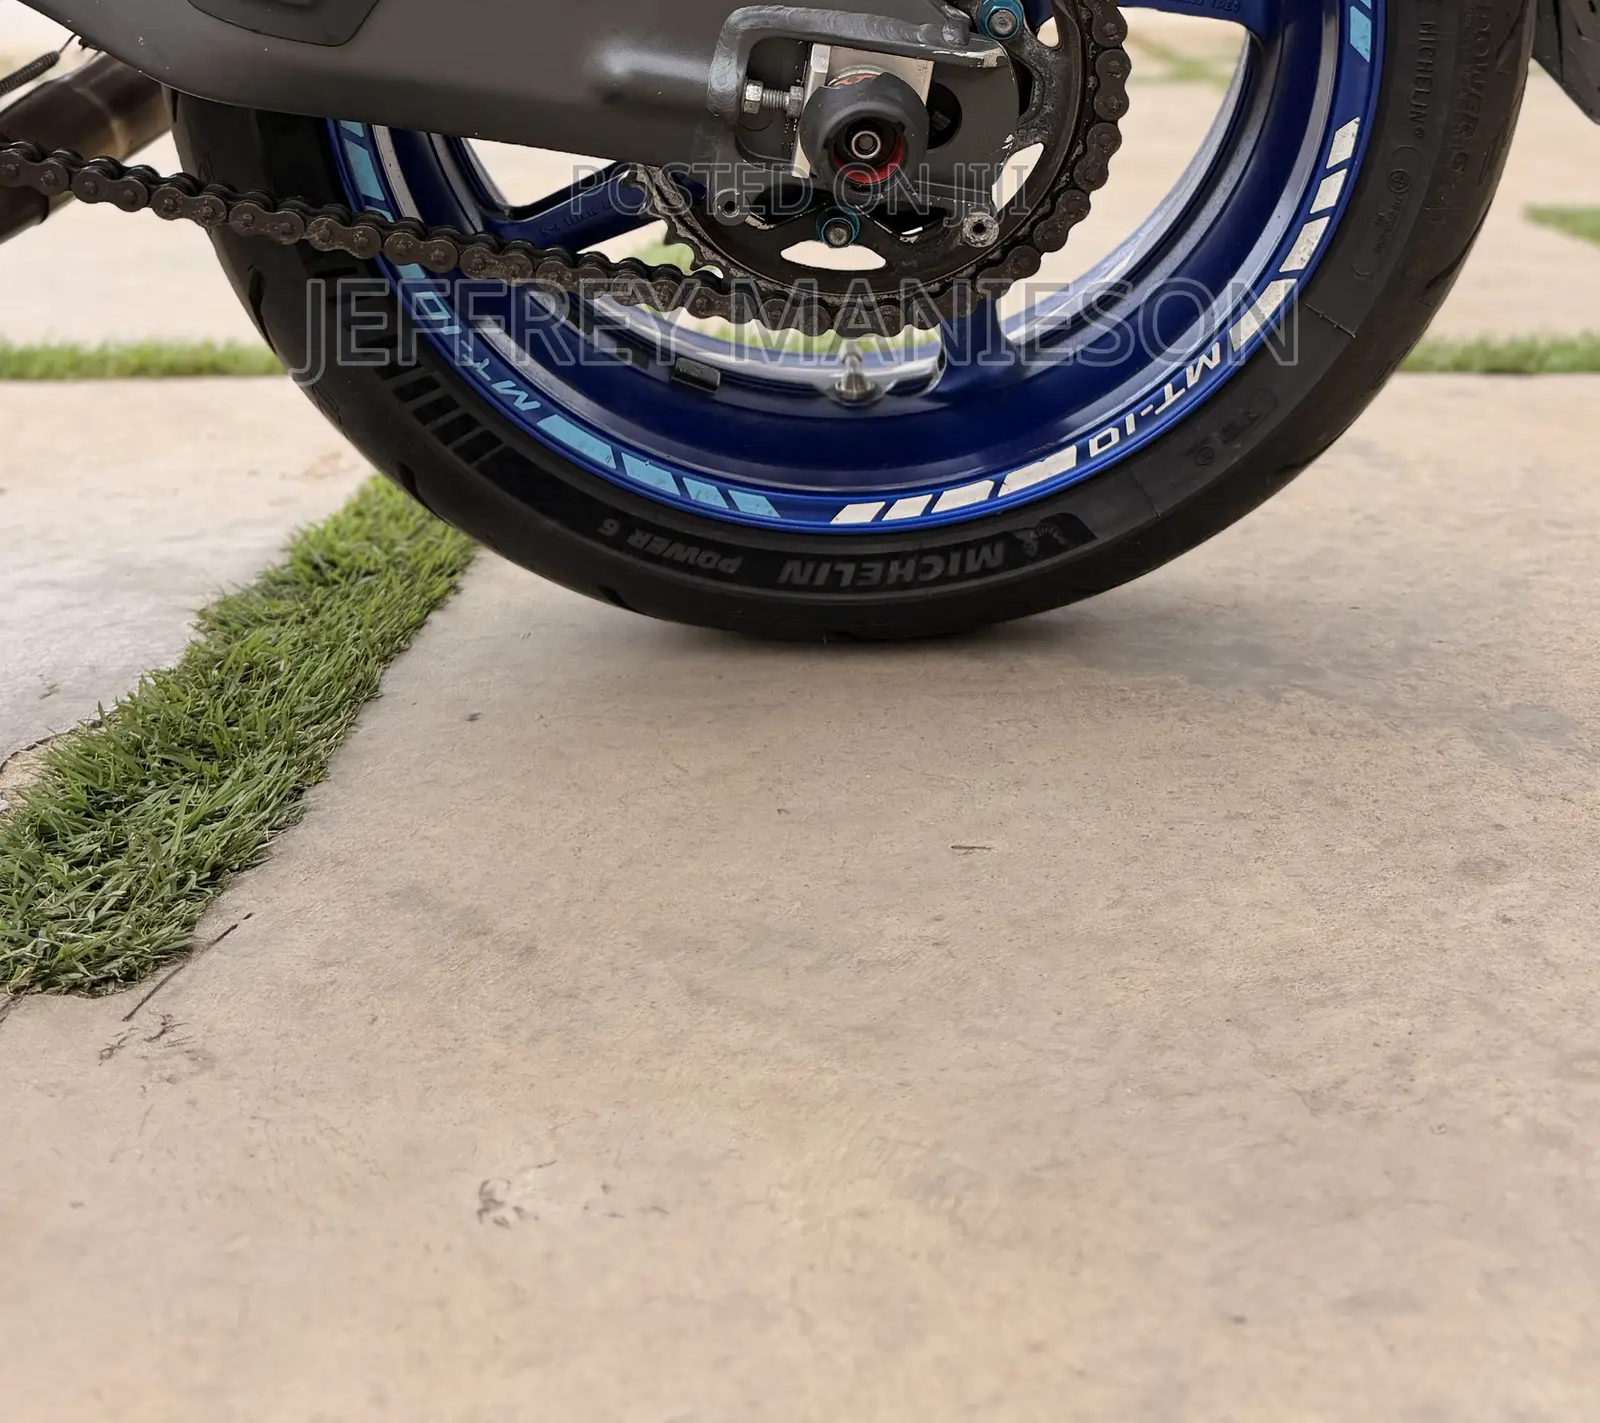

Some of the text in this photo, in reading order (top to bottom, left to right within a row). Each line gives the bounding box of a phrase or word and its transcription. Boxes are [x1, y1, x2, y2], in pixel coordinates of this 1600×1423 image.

[1408, 20, 1438, 124] MICHELIN
[410, 290, 542, 412] MT-10
[1088, 341, 1222, 459] MT-10
[599, 518, 1005, 586] MICHELIN POWER 6
